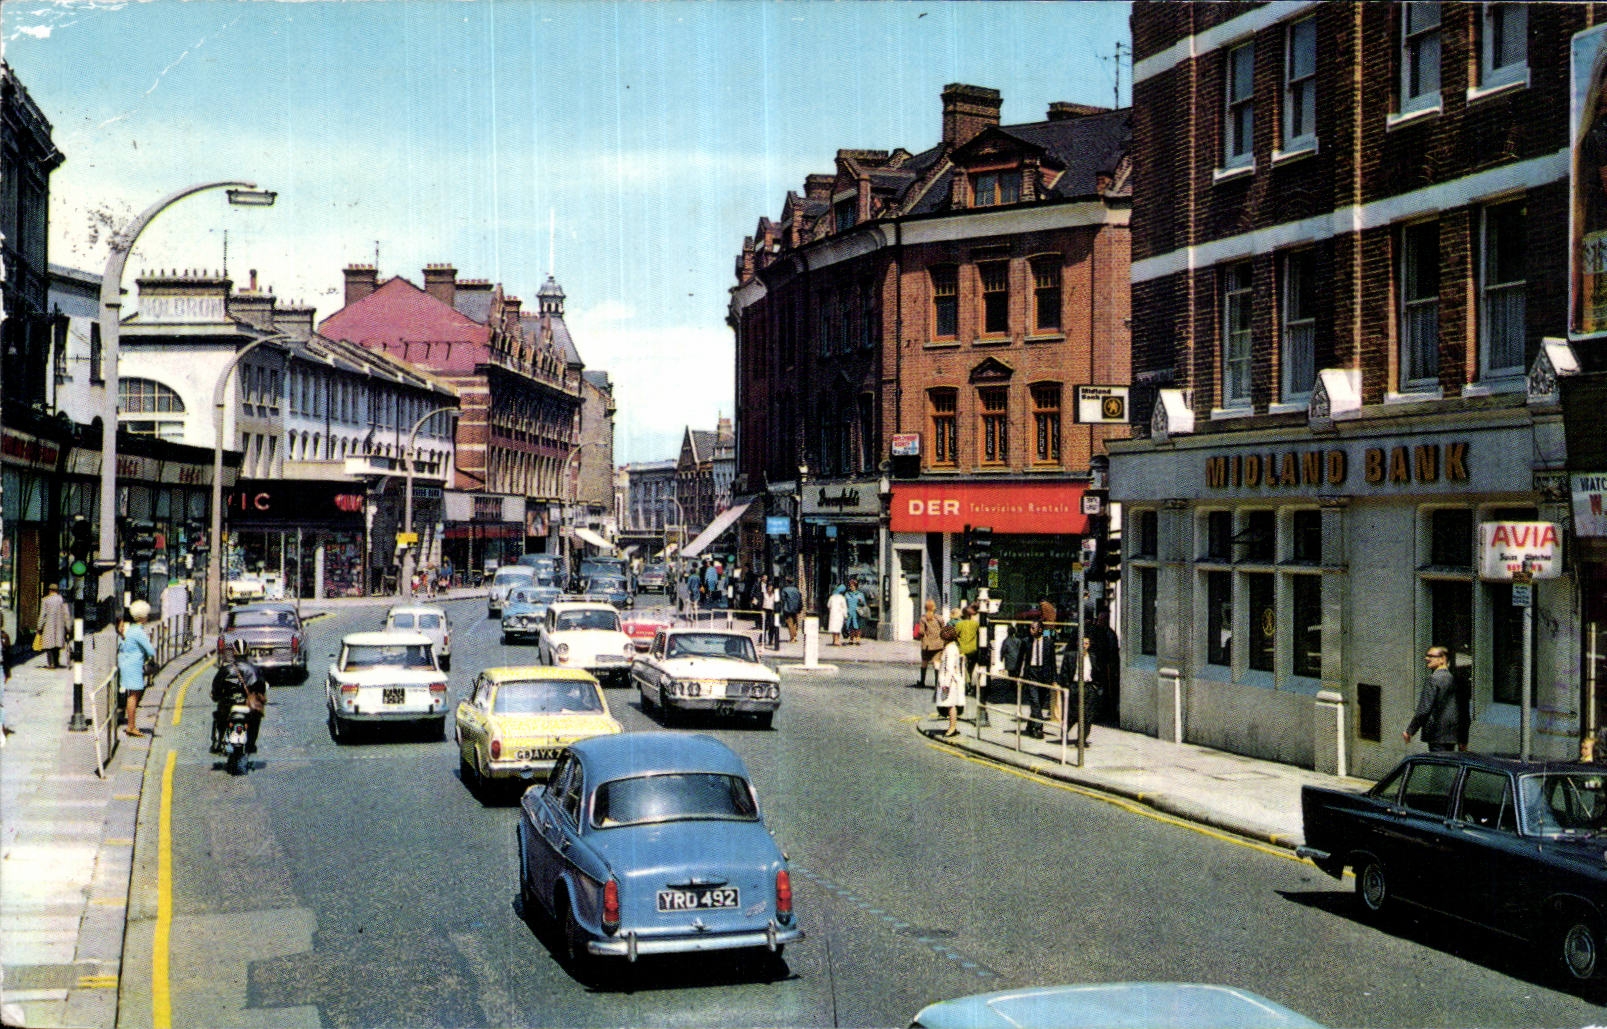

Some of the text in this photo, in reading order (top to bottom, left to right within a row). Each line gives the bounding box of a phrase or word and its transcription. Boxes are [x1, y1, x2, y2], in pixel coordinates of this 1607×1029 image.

[1205, 442, 1470, 488] MIDLAND BANK
[228, 492, 270, 511] IC
[908, 499, 1069, 516] DER Television Rentals
[1491, 525, 1560, 547] AVIA
[661, 890, 735, 909] YRD 492
